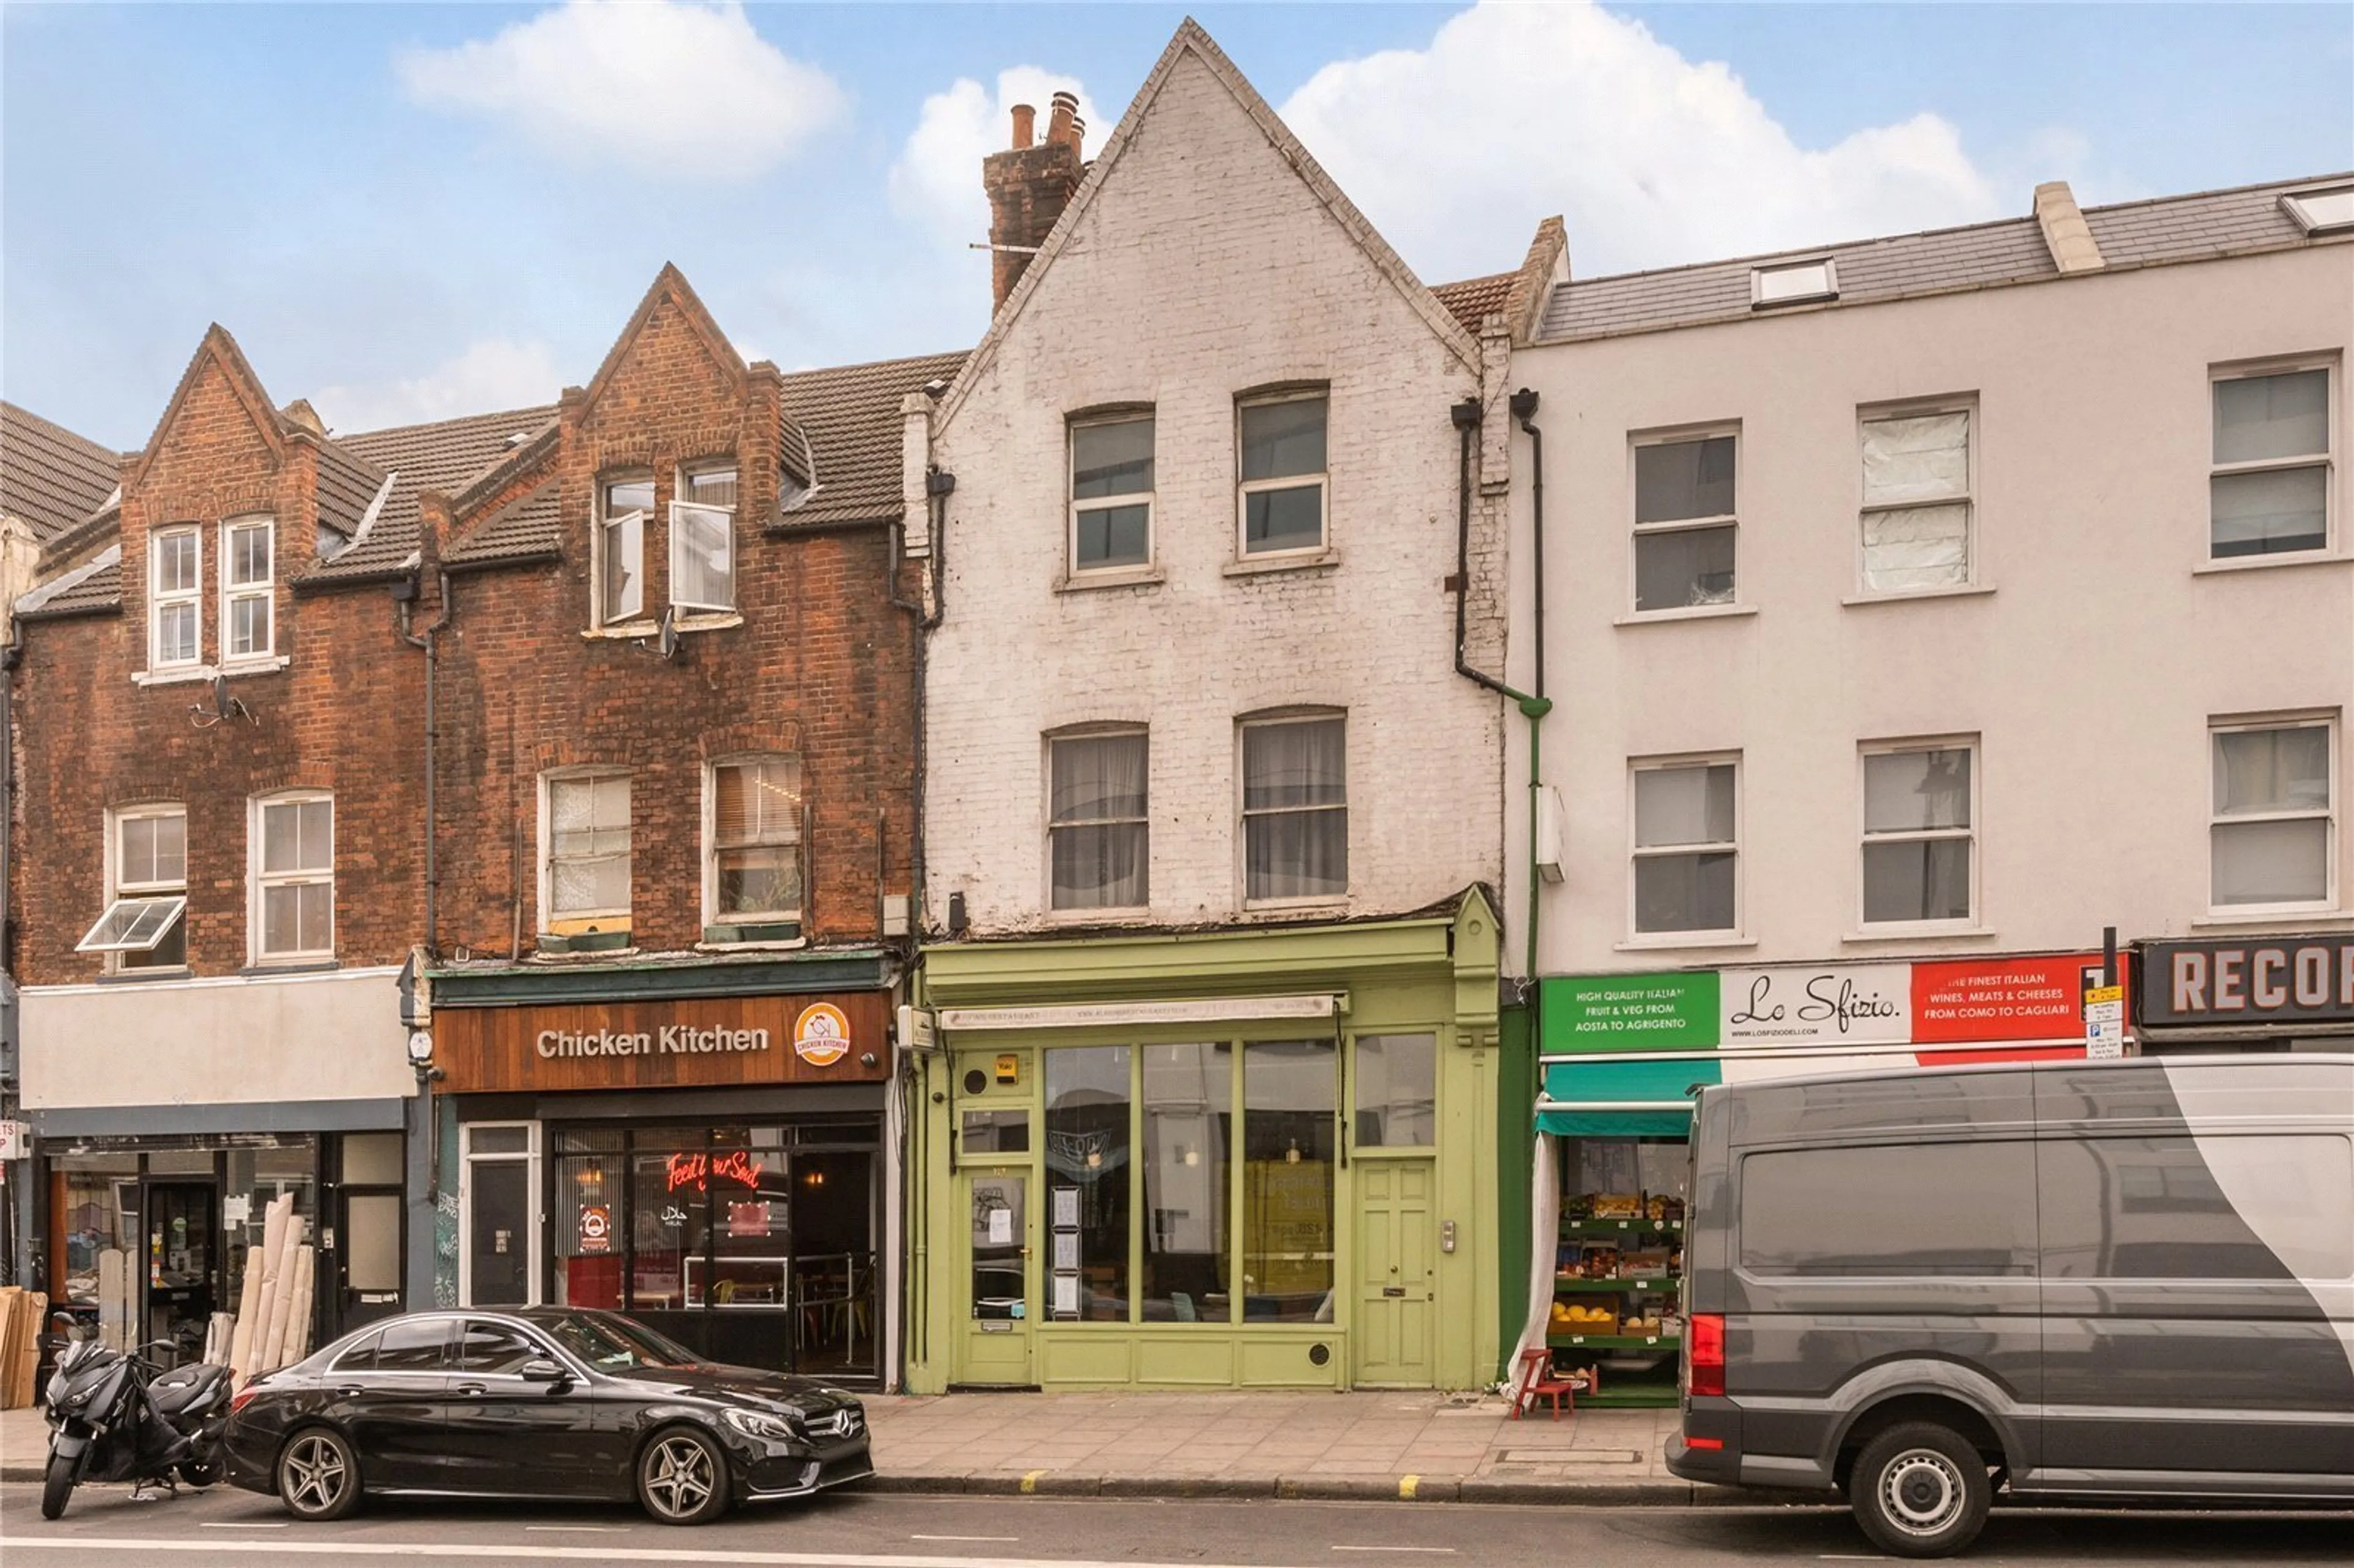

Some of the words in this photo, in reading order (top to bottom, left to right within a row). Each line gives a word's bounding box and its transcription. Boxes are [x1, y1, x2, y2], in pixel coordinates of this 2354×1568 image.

[1968, 975, 2002, 986] FINEST
[2004, 973, 2045, 984] ITALIAN
[1576, 992, 1602, 1002] HIGH
[1604, 990, 1644, 1001] QUALITY
[1968, 991, 2003, 1002] MEATS
[2006, 991, 2014, 1000] &
[2017, 989, 2063, 1000] CHEESES
[1585, 1006, 1610, 1016] FRUIT
[1612, 1007, 1620, 1016] &
[1623, 1005, 1643, 1015] VEG
[1646, 1003, 1675, 1014] FROM
[1731, 975, 1785, 1024] Lo
[1797, 975, 1900, 1033] Sfizio.
[1924, 1009, 1956, 1019] FROM
[1958, 1008, 1995, 1018] COMO
[1999, 1006, 2013, 1016] TO
[2016, 1005, 2070, 1015] CAGLIARI
[1575, 1022, 1609, 1032] AOSTA
[1610, 1021, 1624, 1030] TO
[1626, 1019, 1686, 1030] AGRIGENTO
[536, 1029, 651, 1058] Chicken
[659, 1024, 769, 1053] Kitchen
[0, 1124, 14, 1135] TS
